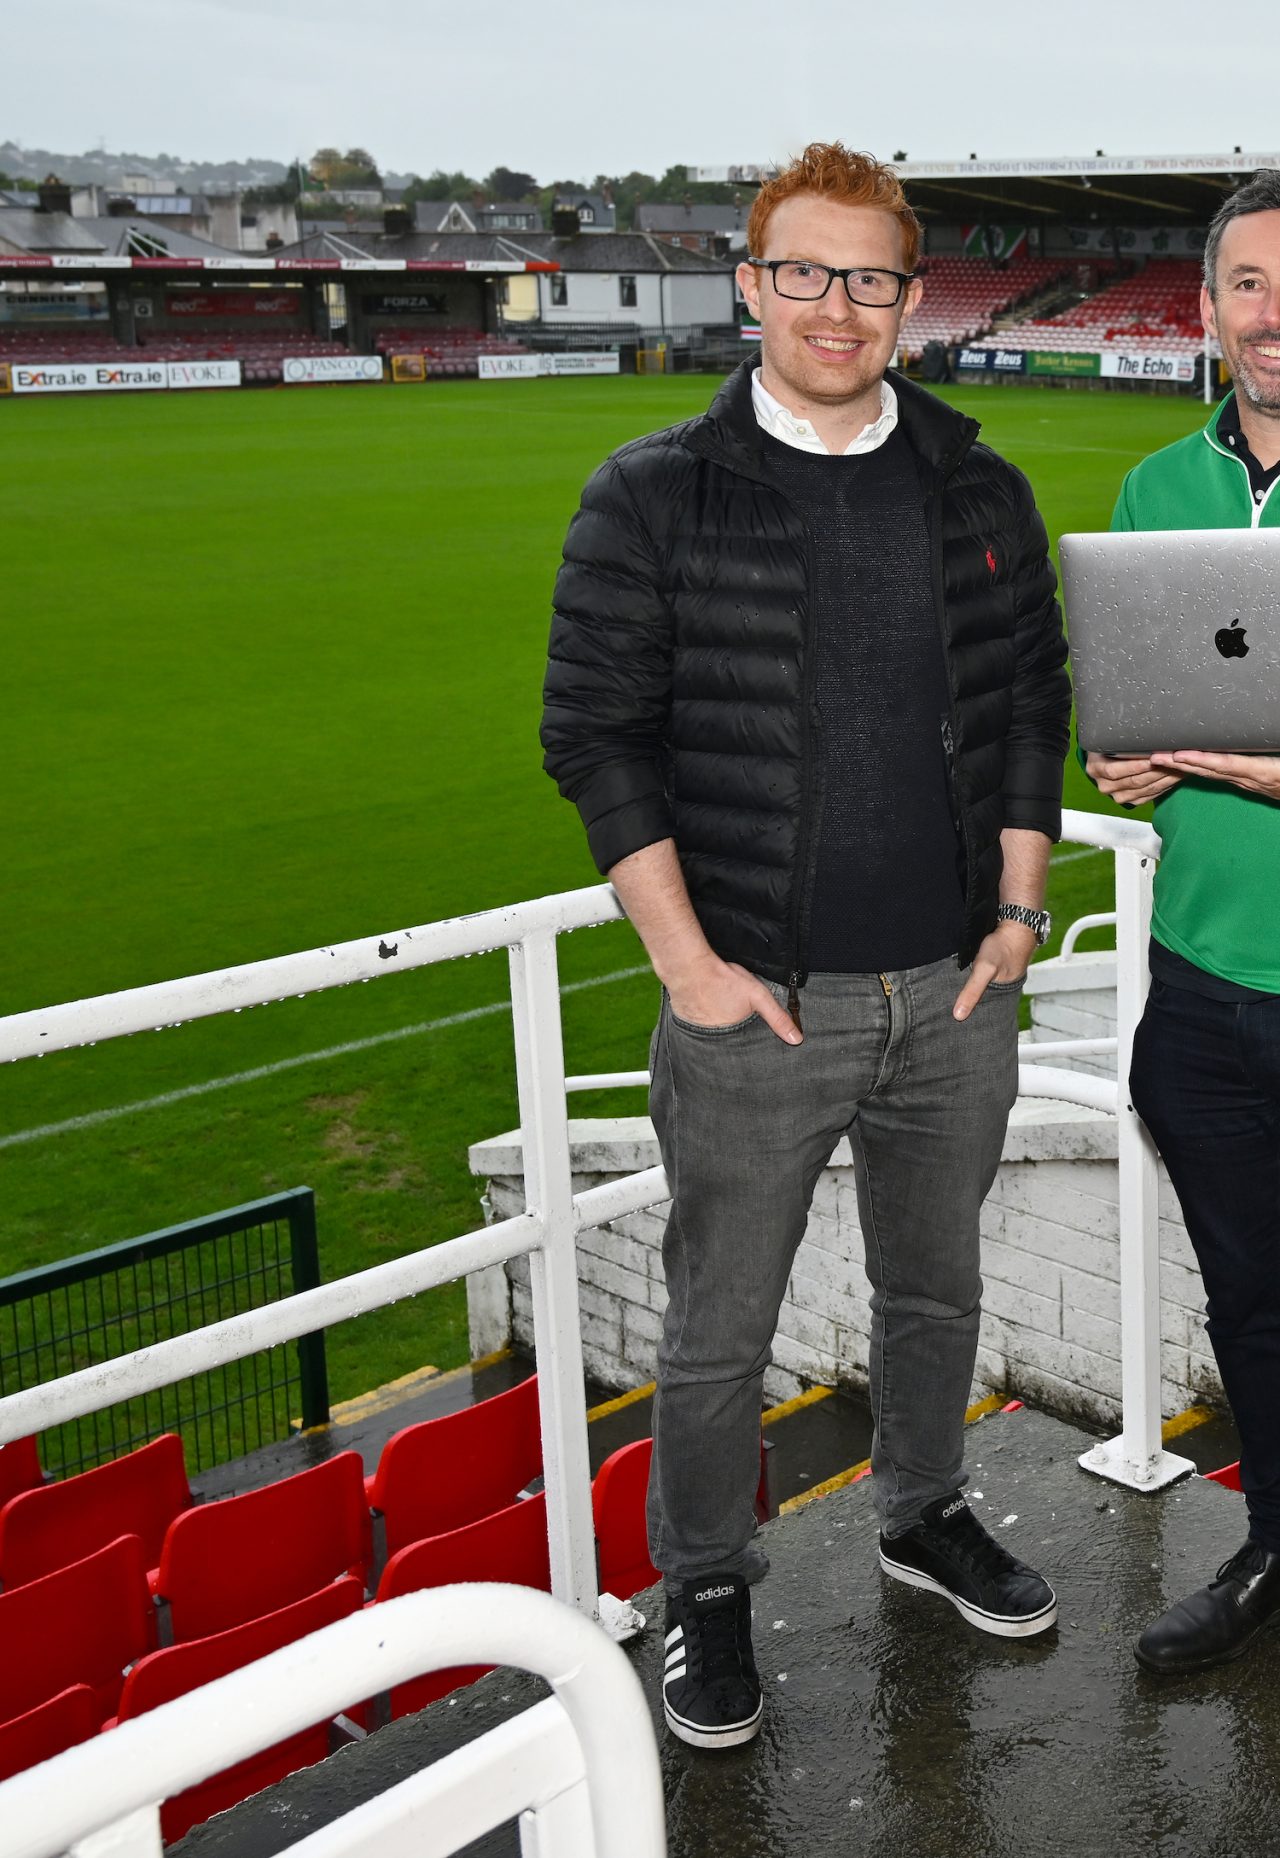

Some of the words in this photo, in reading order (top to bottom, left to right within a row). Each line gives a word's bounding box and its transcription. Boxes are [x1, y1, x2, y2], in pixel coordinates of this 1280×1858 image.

[383, 296, 429, 307] FORZA
[960, 350, 987, 364] Zeus
[994, 351, 1023, 366] Zeus
[172, 365, 226, 382] EVOKE
[482, 360, 524, 375] EVOKE
[1118, 356, 1139, 374] The
[1143, 357, 1173, 376] Echo
[18, 370, 87, 386] Extra.ie
[96, 367, 162, 384] Extra.ie
[695, 1584, 736, 1602] adidas
